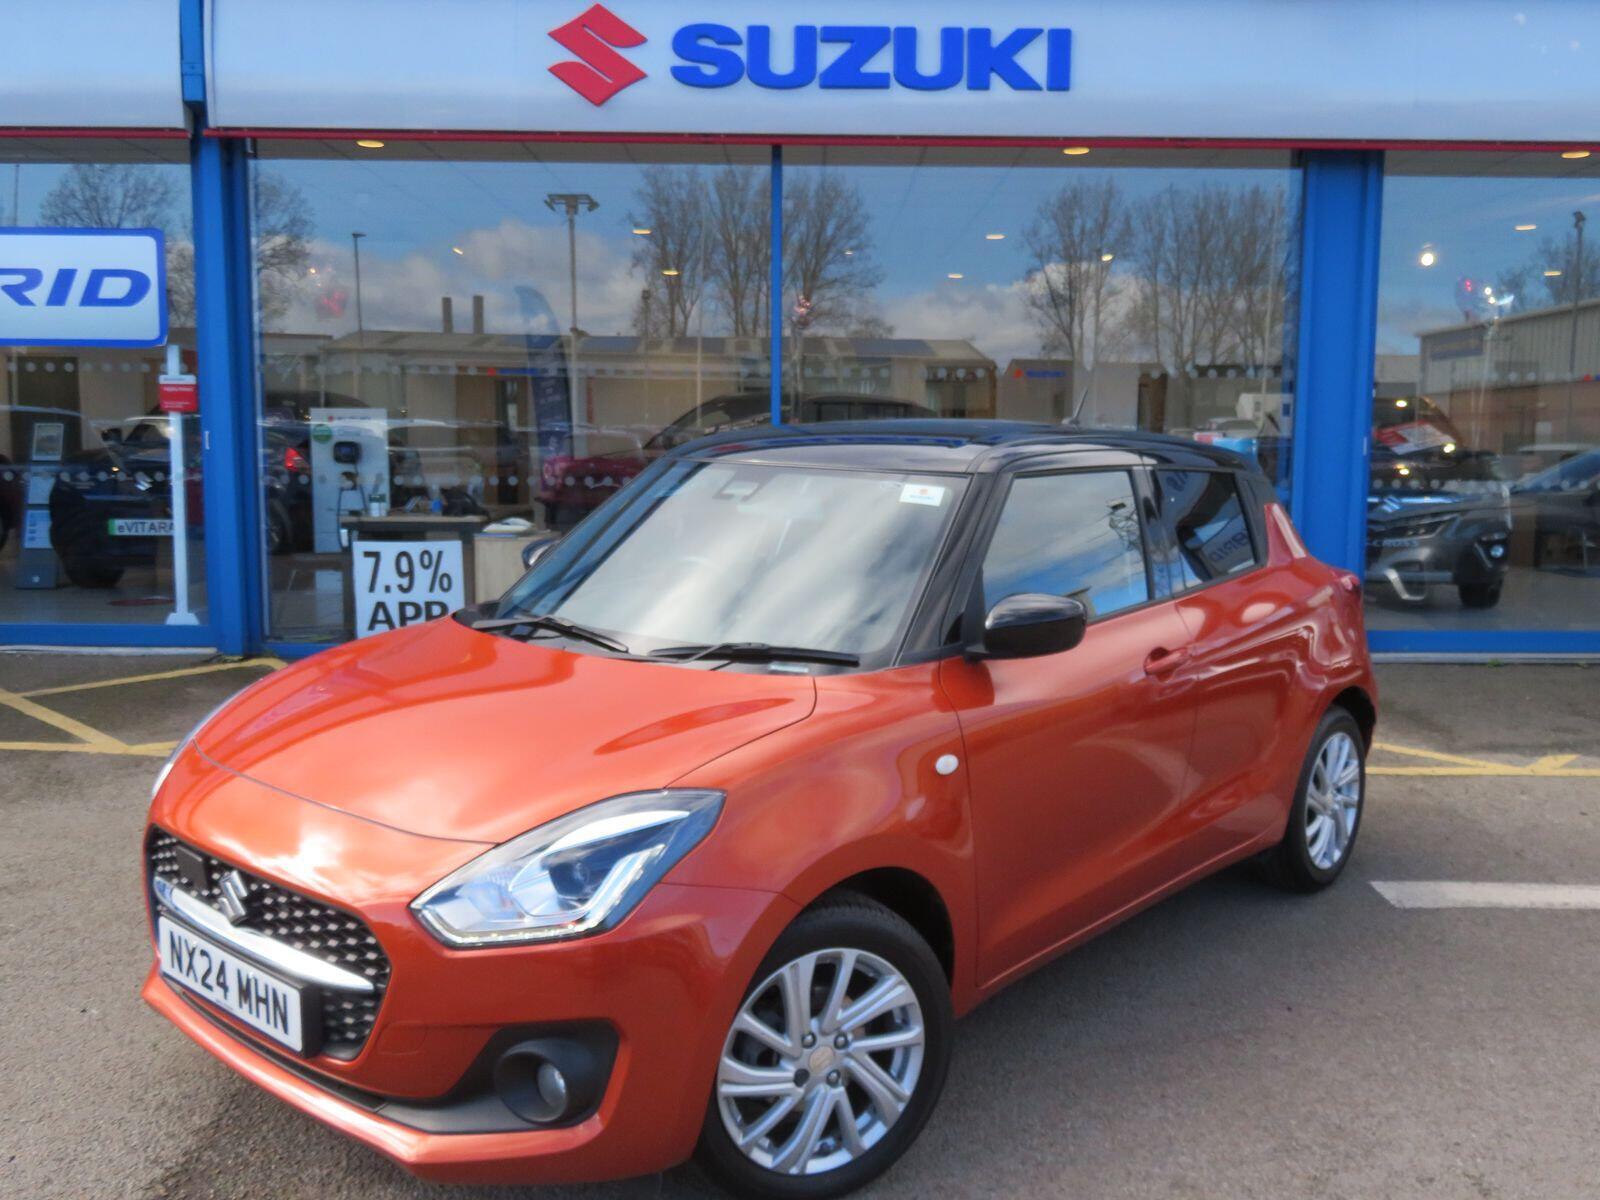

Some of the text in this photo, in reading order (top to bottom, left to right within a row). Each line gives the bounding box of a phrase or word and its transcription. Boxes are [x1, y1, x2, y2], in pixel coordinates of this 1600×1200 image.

[670, 23, 1072, 91] SUZUKI
[363, 550, 453, 594] 7.9%
[169, 930, 289, 1035] NX24 MHN
